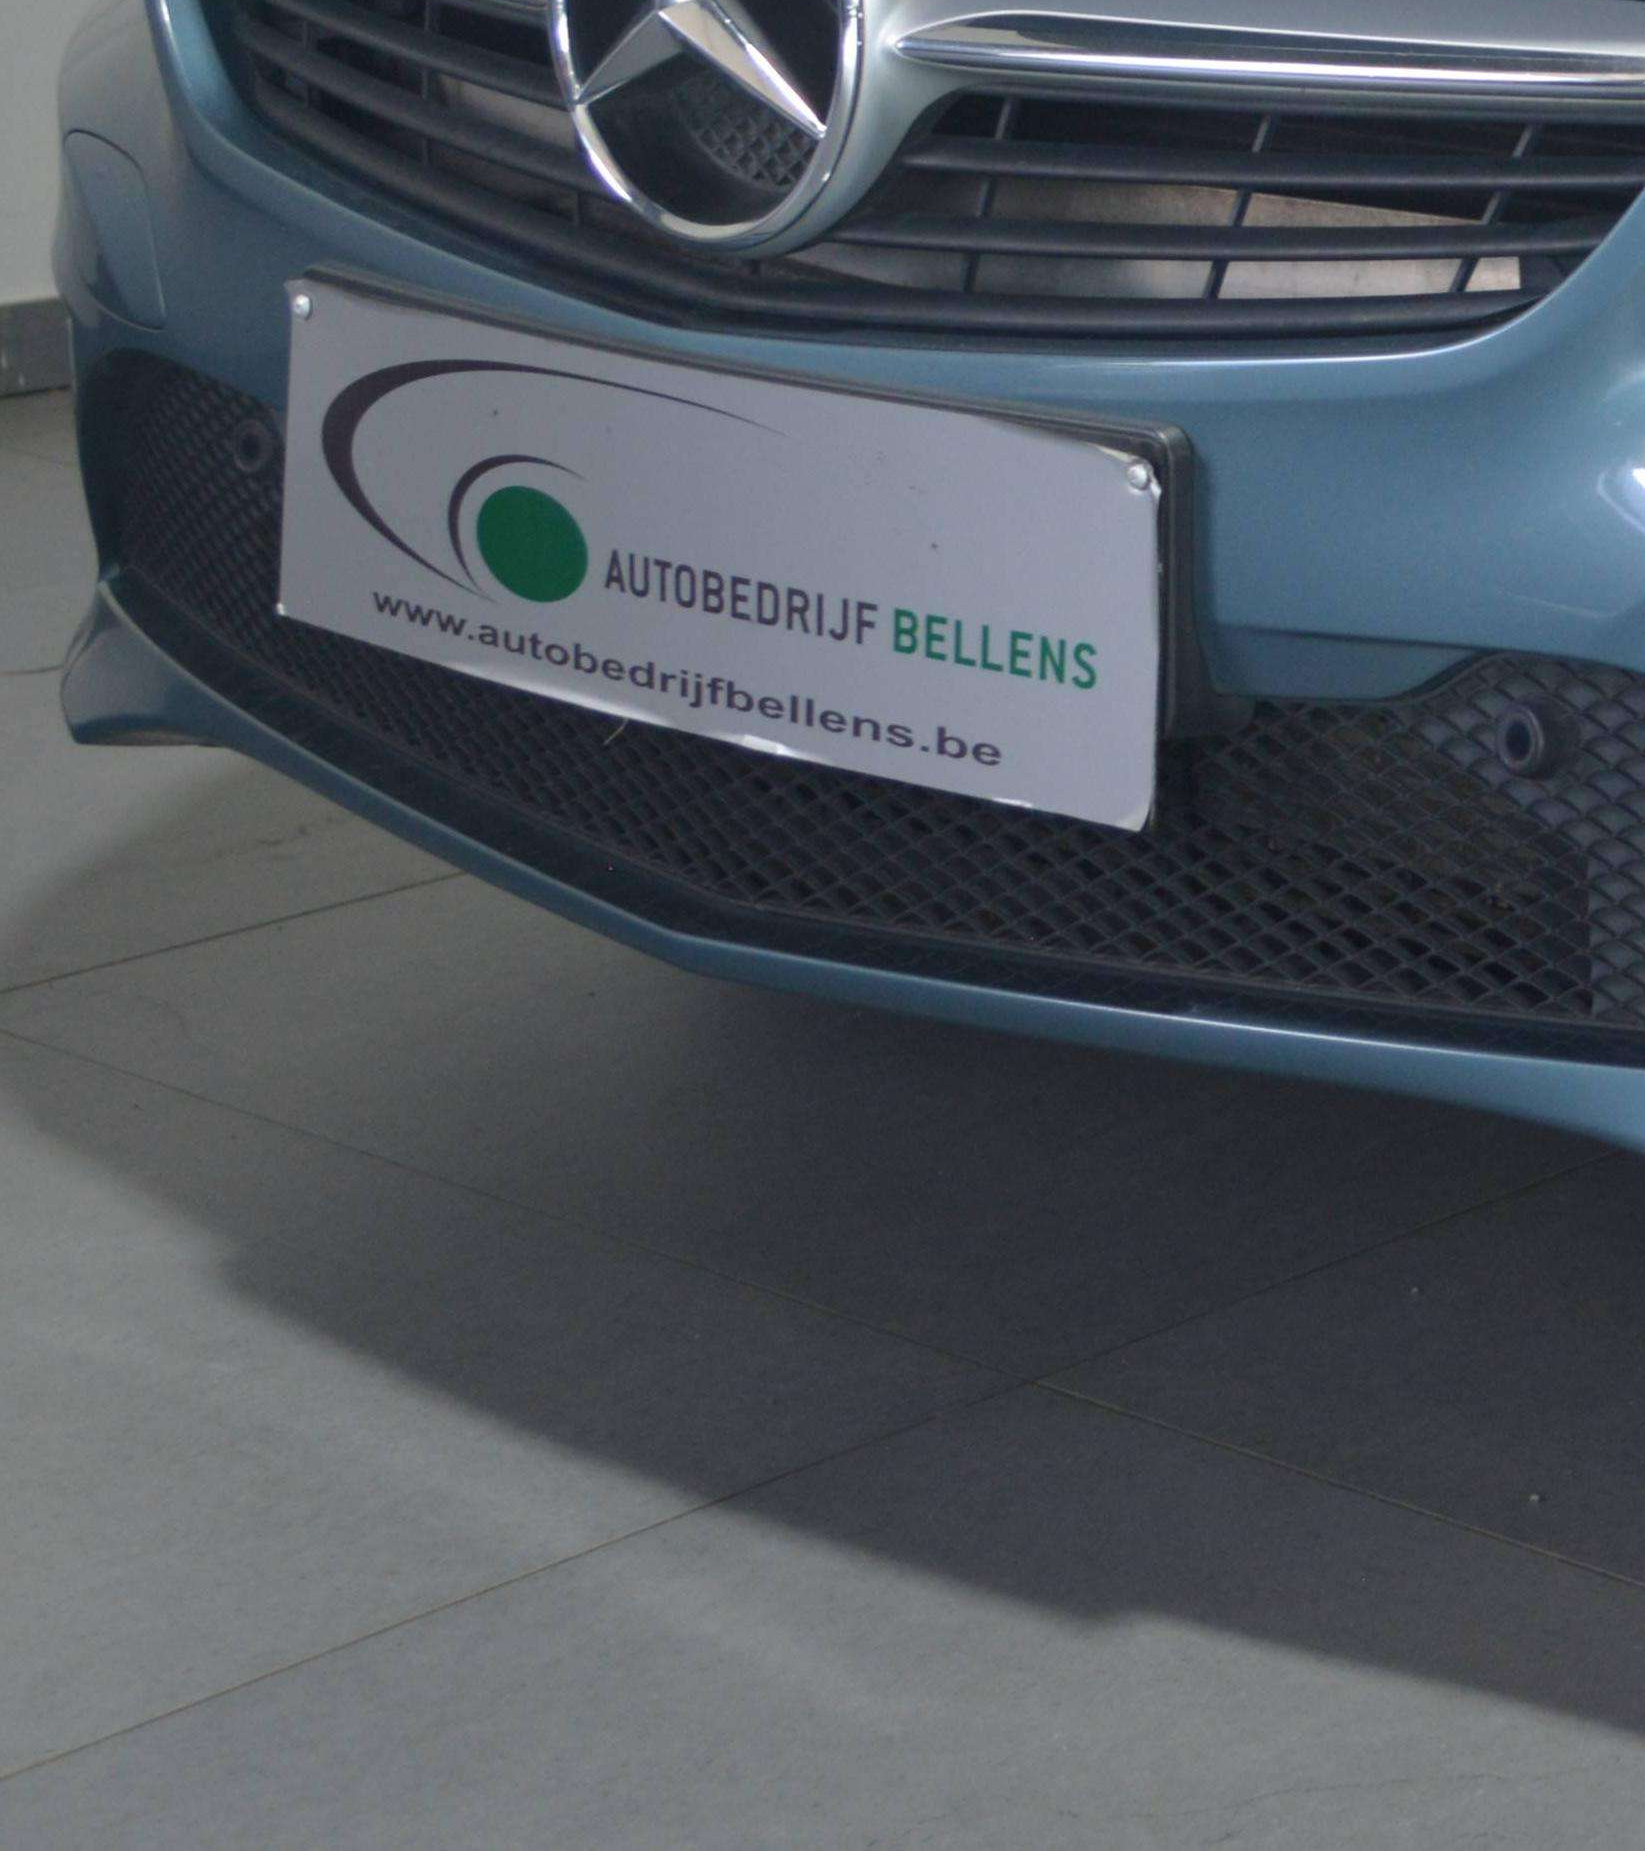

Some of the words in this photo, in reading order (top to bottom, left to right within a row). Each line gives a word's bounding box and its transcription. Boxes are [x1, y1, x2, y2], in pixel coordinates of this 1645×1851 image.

[371, 592, 1003, 767] www.autobedrijfbellens.be
[604, 549, 878, 646] AUTOBEDRIJF
[893, 607, 1098, 690] BELLENS
